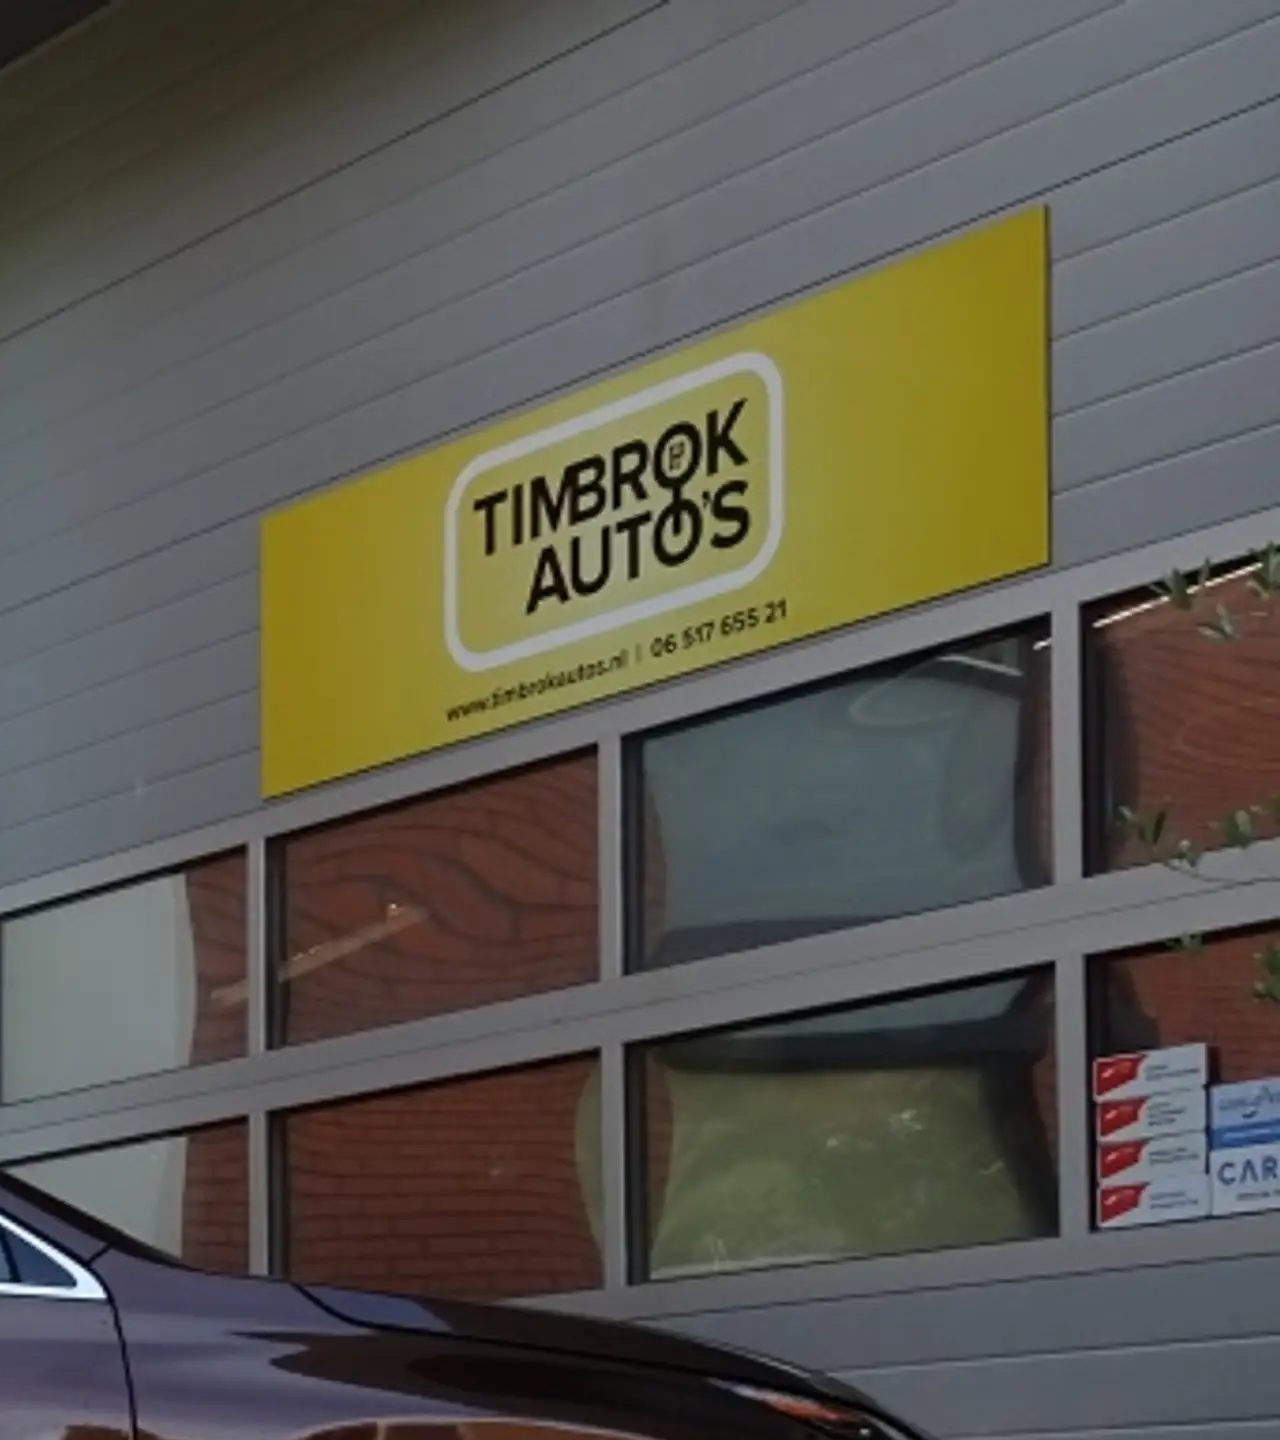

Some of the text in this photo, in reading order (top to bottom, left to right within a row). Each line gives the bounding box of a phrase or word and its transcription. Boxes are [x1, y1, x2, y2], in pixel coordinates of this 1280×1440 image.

[473, 398, 749, 556] TIMBROK
[526, 480, 751, 615] AUTO'S
[446, 597, 787, 722] www.timbrokautos.nl 06 517 655 21
